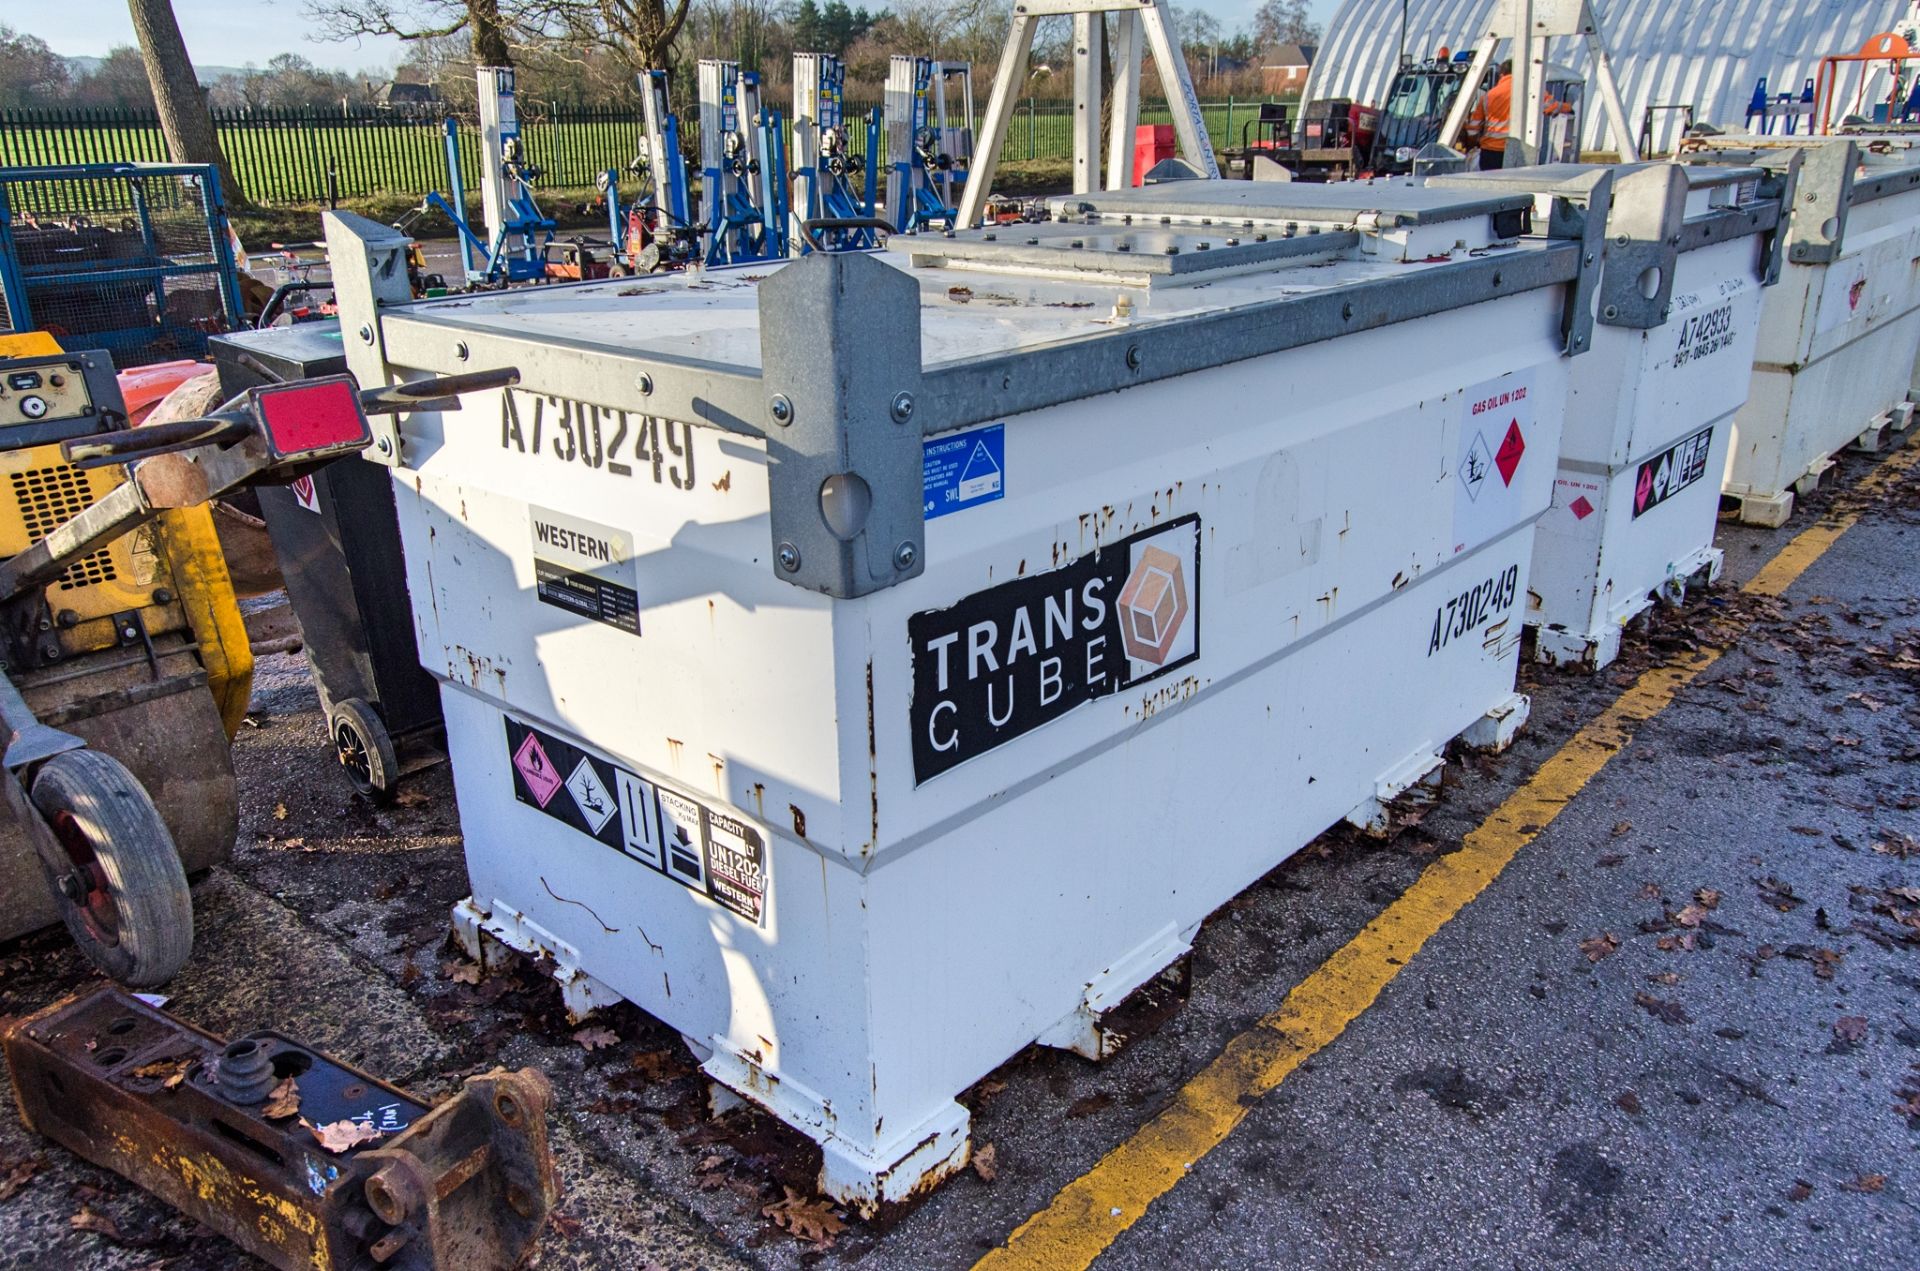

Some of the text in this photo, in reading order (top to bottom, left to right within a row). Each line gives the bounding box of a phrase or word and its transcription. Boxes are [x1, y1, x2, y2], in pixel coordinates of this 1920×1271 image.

[1677, 305, 1732, 350] A742933
[1471, 386, 1528, 416] GAS OIL UN 1202
[501, 388, 696, 491] A730249
[926, 440, 967, 456] INSTRUCTIONS
[945, 487, 959, 503] SWL
[535, 520, 609, 563] WESTERN
[1428, 564, 1518, 658] A730249
[927, 577, 1106, 692] TRANS
[928, 636, 1106, 752] CUBE
[661, 794, 697, 817] STACKING
[709, 812, 745, 837] CAPACITY
[745, 844, 755, 858] LT
[710, 858, 740, 882] DIESEL
[712, 878, 755, 908] WESTERN
